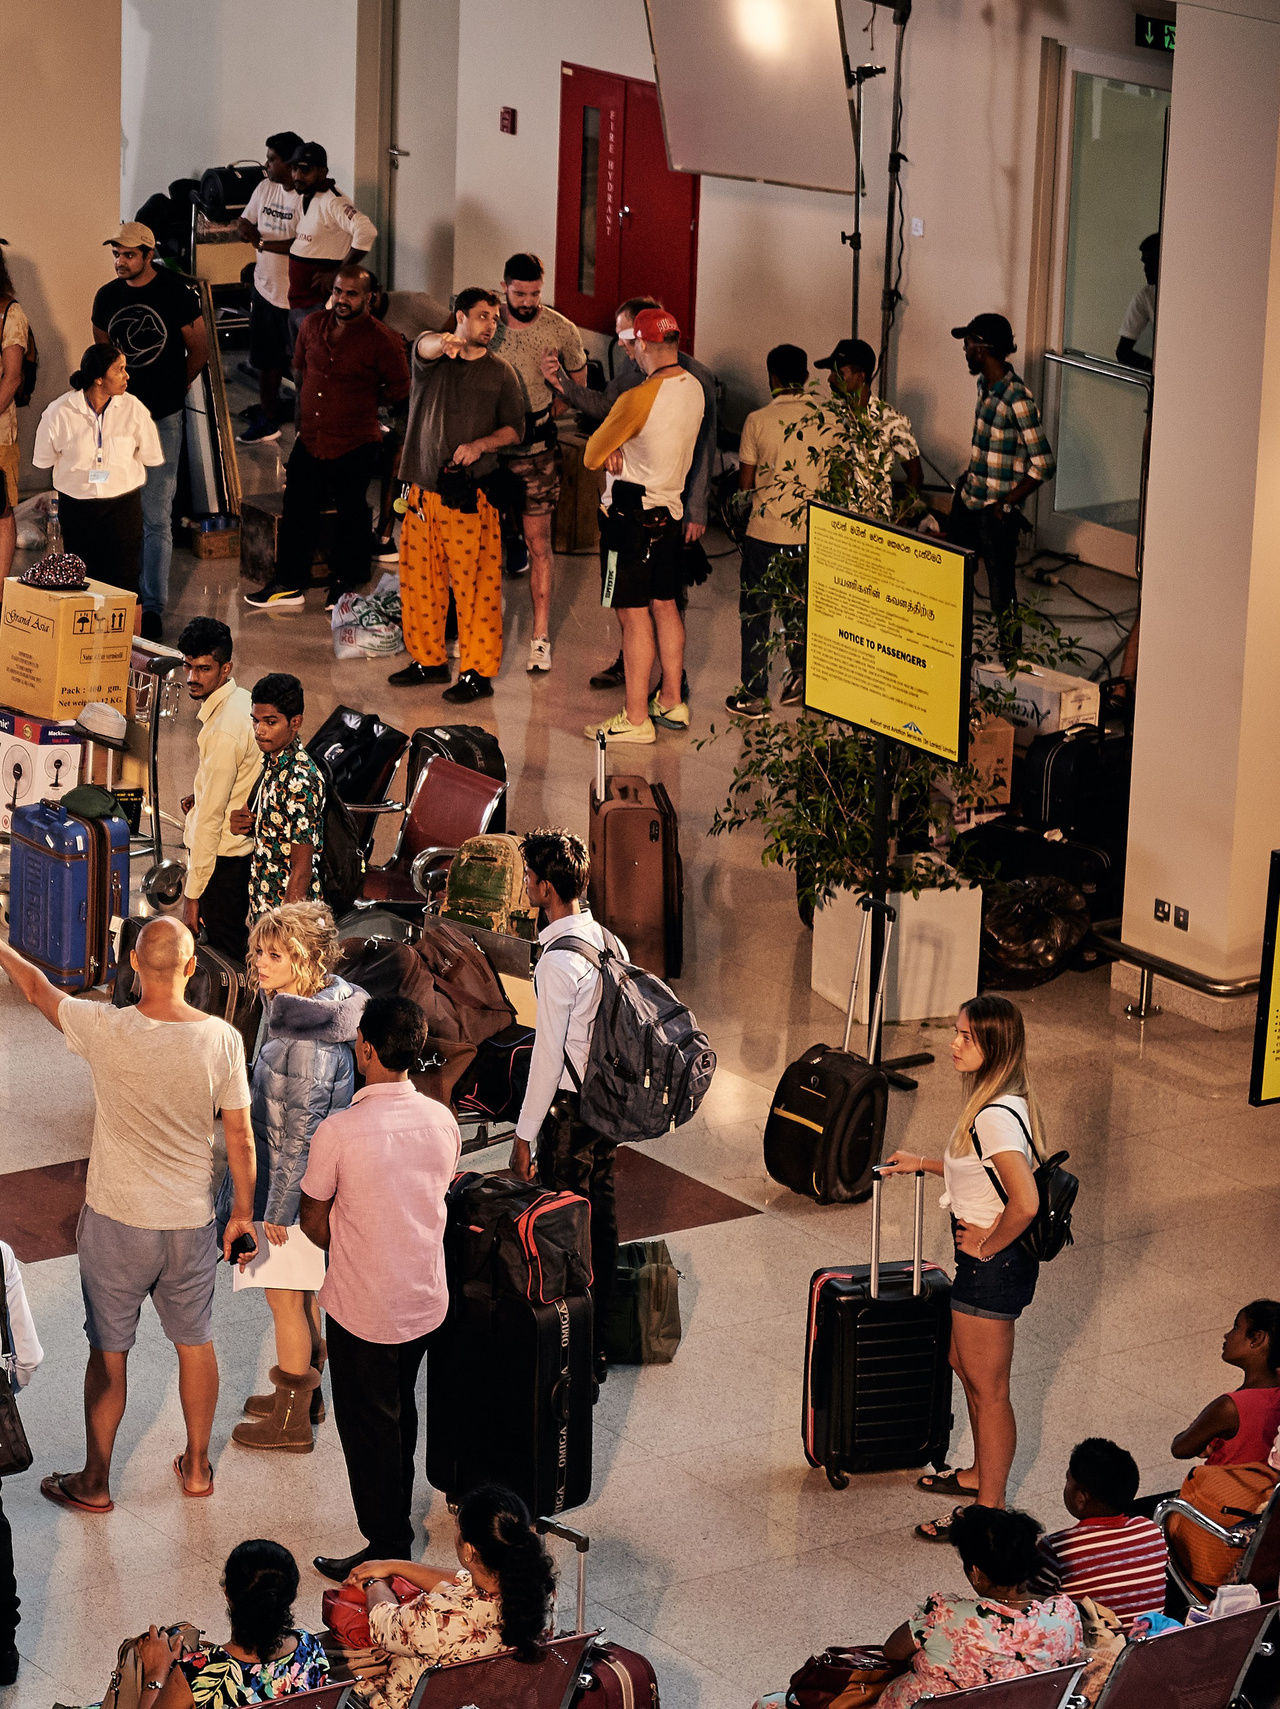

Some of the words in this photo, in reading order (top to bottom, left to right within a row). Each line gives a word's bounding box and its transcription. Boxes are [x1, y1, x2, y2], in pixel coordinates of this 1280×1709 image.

[608, 110, 616, 154] FIRE
[605, 159, 614, 236] HYDRANT
[5, 609, 31, 627] Grand
[31, 616, 51, 633] Asia
[341, 636, 354, 645] KG
[838, 628, 865, 646] NOTICE
[866, 639, 876, 650] TO
[877, 643, 927, 669] PASSENGERS
[61, 687, 81, 695] Pack
[560, 1304, 570, 1348] OMIGA
[558, 1426, 568, 1468] OMIGA
